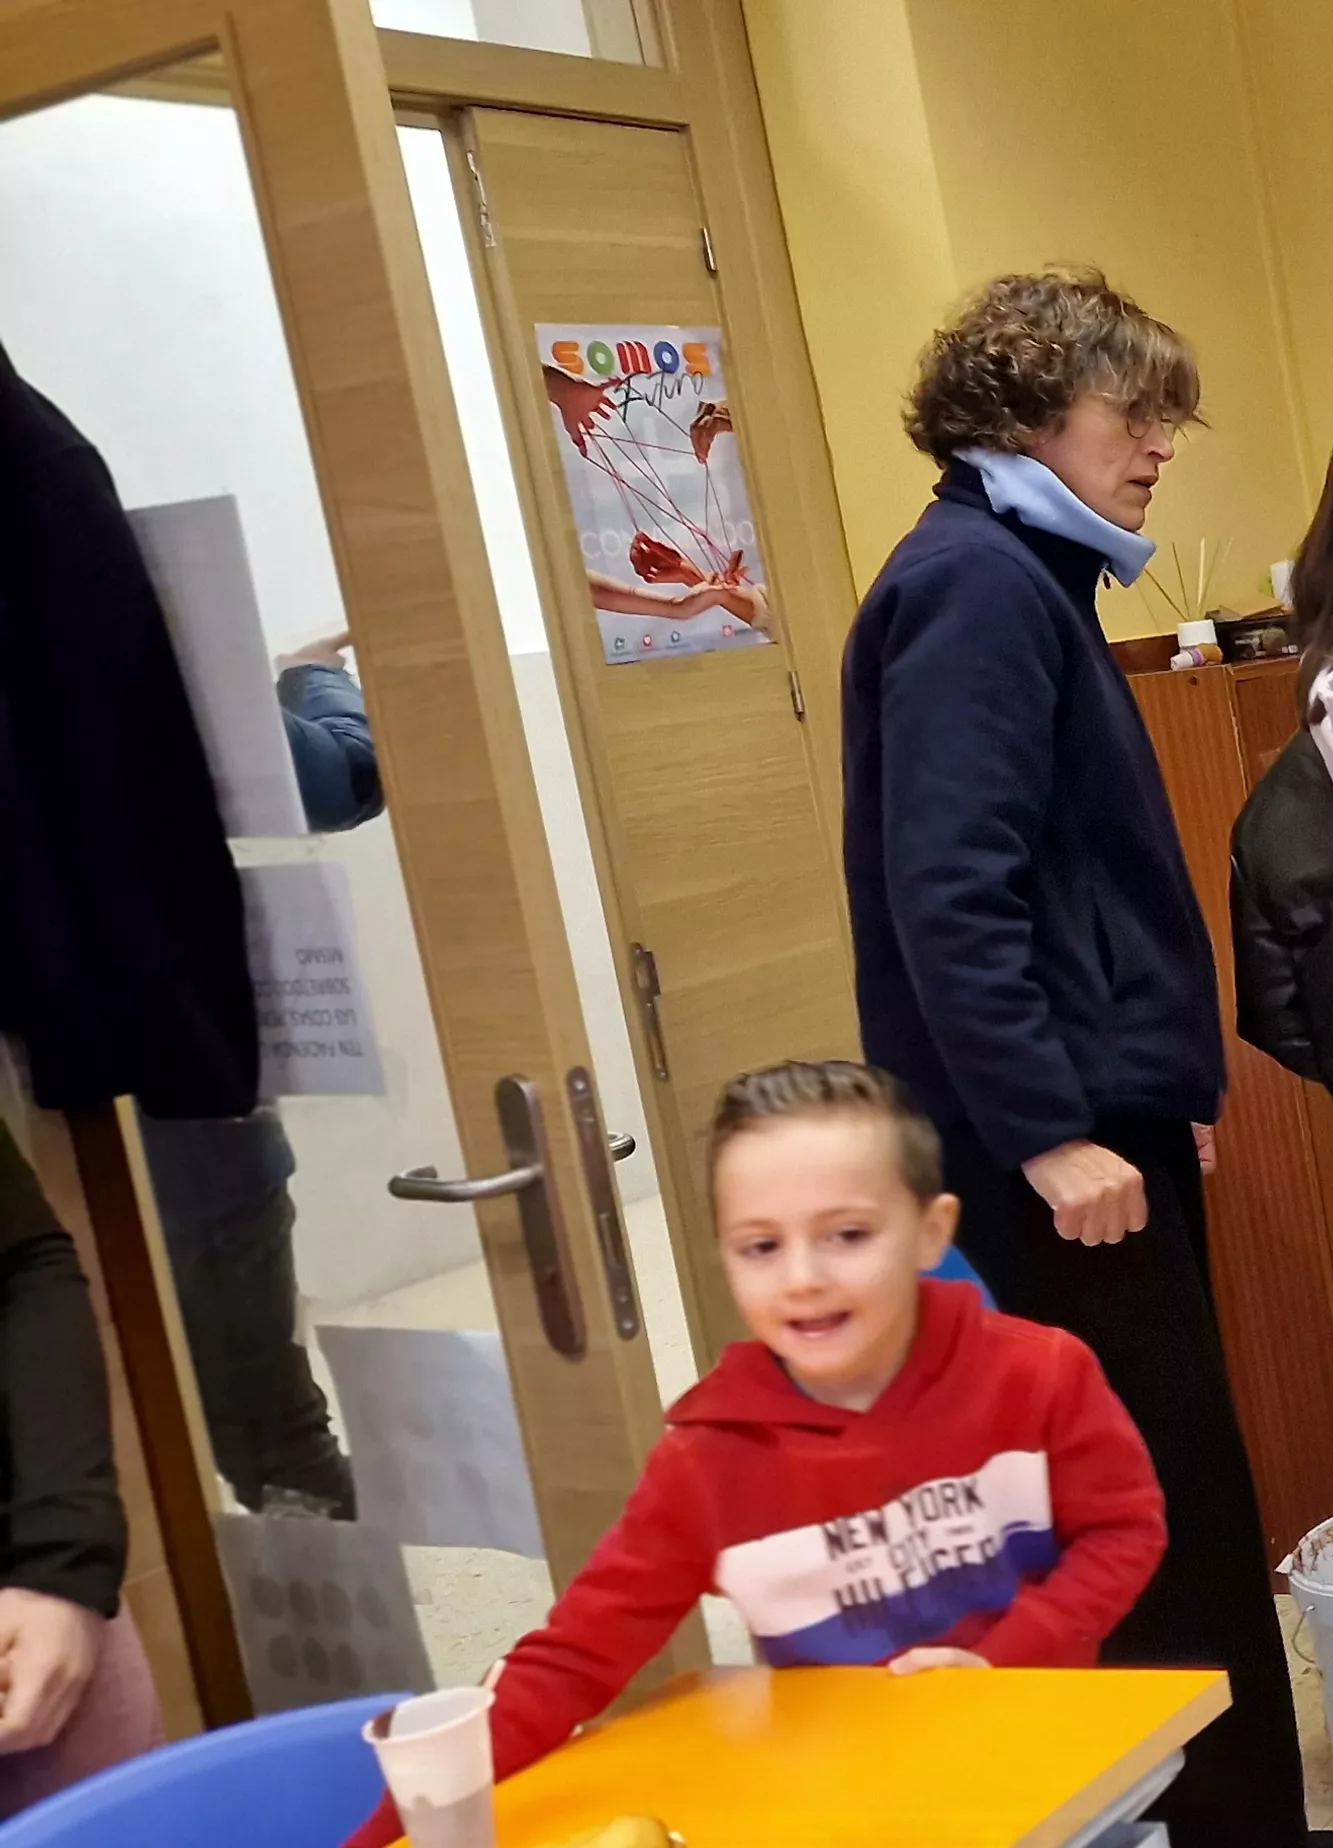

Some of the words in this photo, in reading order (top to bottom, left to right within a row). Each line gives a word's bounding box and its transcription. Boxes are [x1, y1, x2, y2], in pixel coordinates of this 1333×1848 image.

[551, 340, 712, 375] SOMOS
[823, 1507, 889, 1561] NEW
[900, 1478, 985, 1528] YORK
